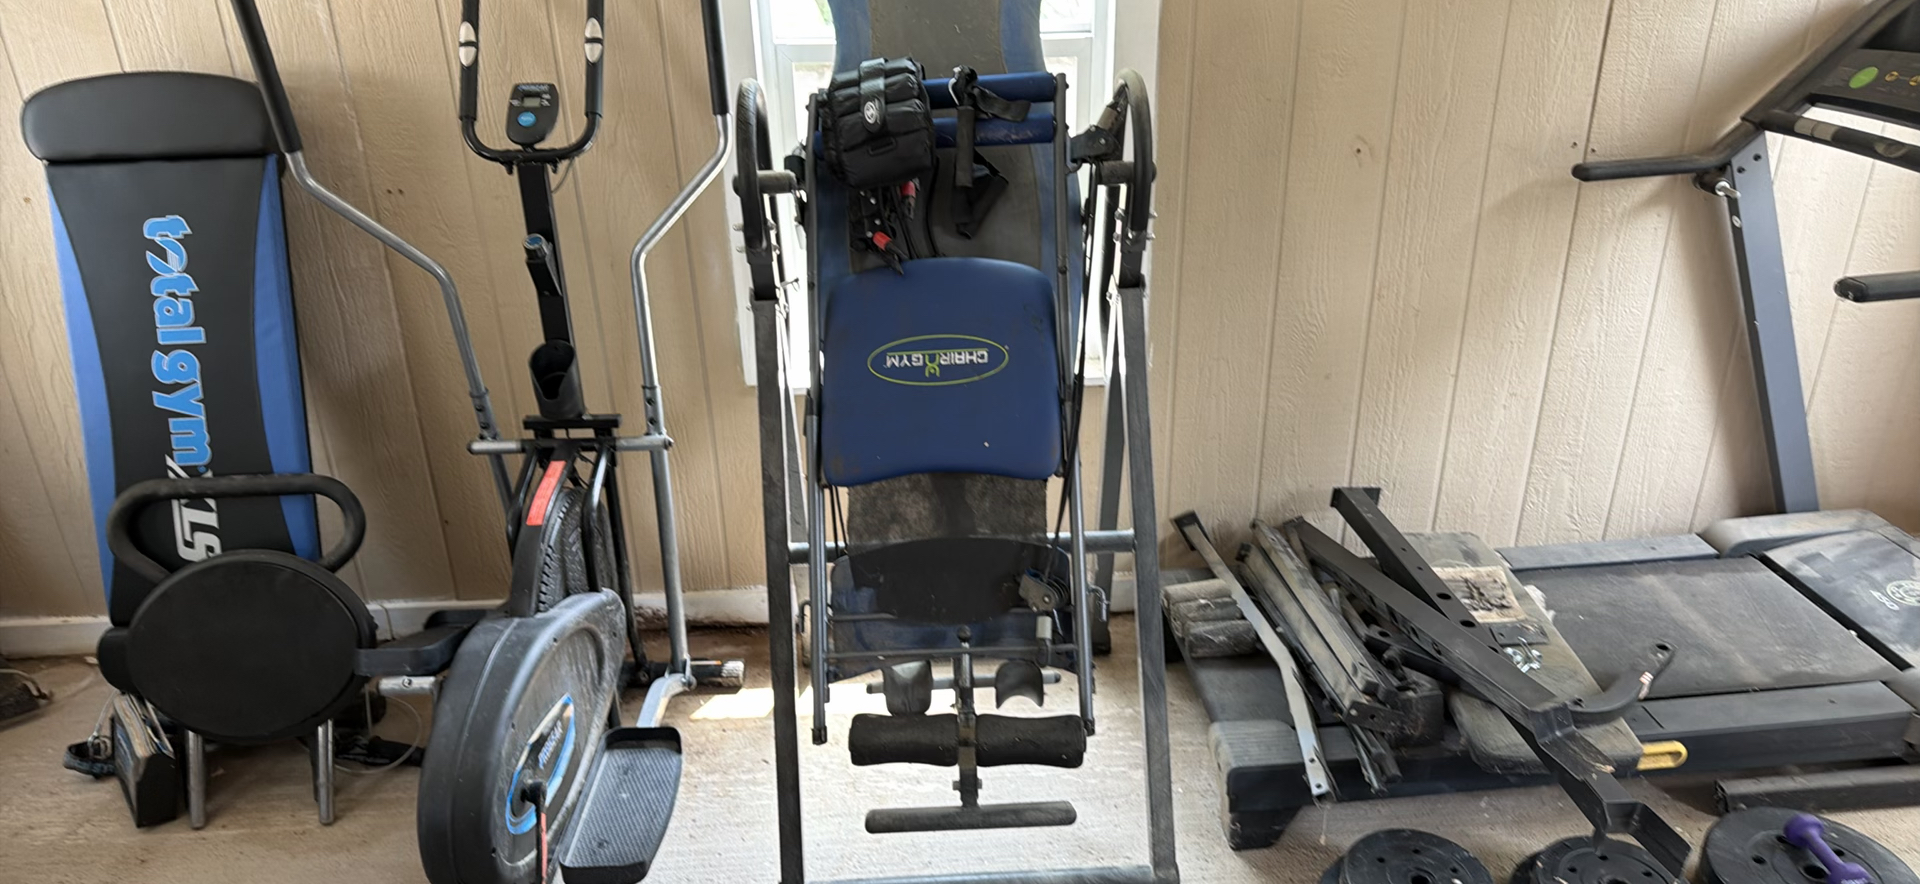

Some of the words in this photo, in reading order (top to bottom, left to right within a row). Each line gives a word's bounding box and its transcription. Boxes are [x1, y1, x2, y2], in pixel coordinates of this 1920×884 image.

[143, 214, 207, 345] total
[885, 353, 924, 368] GYM
[939, 350, 988, 365] CHAIR
[151, 349, 213, 466] gym
